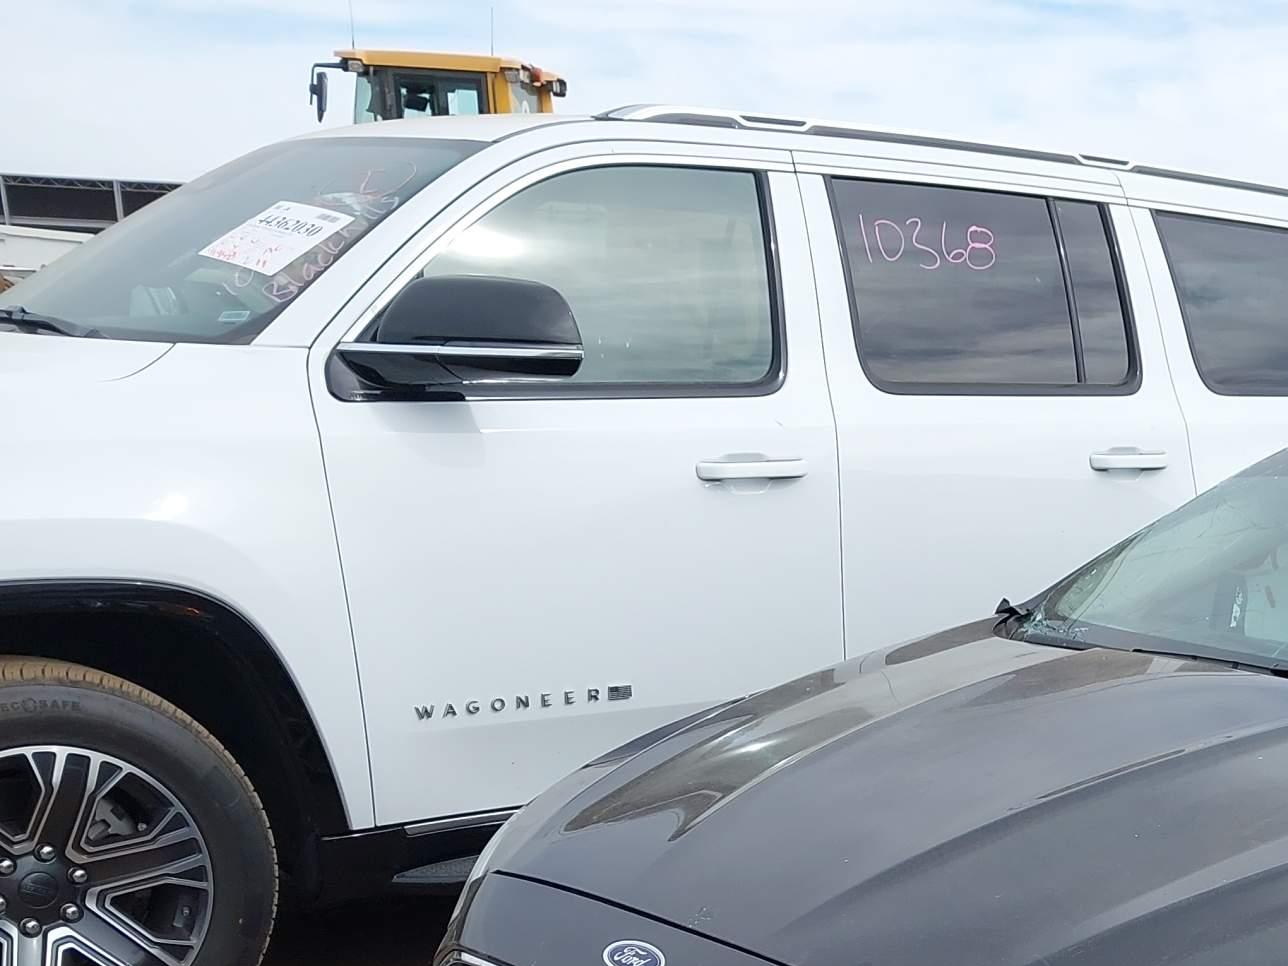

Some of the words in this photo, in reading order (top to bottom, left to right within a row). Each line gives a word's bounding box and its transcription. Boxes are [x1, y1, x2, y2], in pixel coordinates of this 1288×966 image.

[257, 213, 324, 237] 44362030
[859, 214, 996, 270] 10368
[414, 688, 600, 720] WAGONEER
